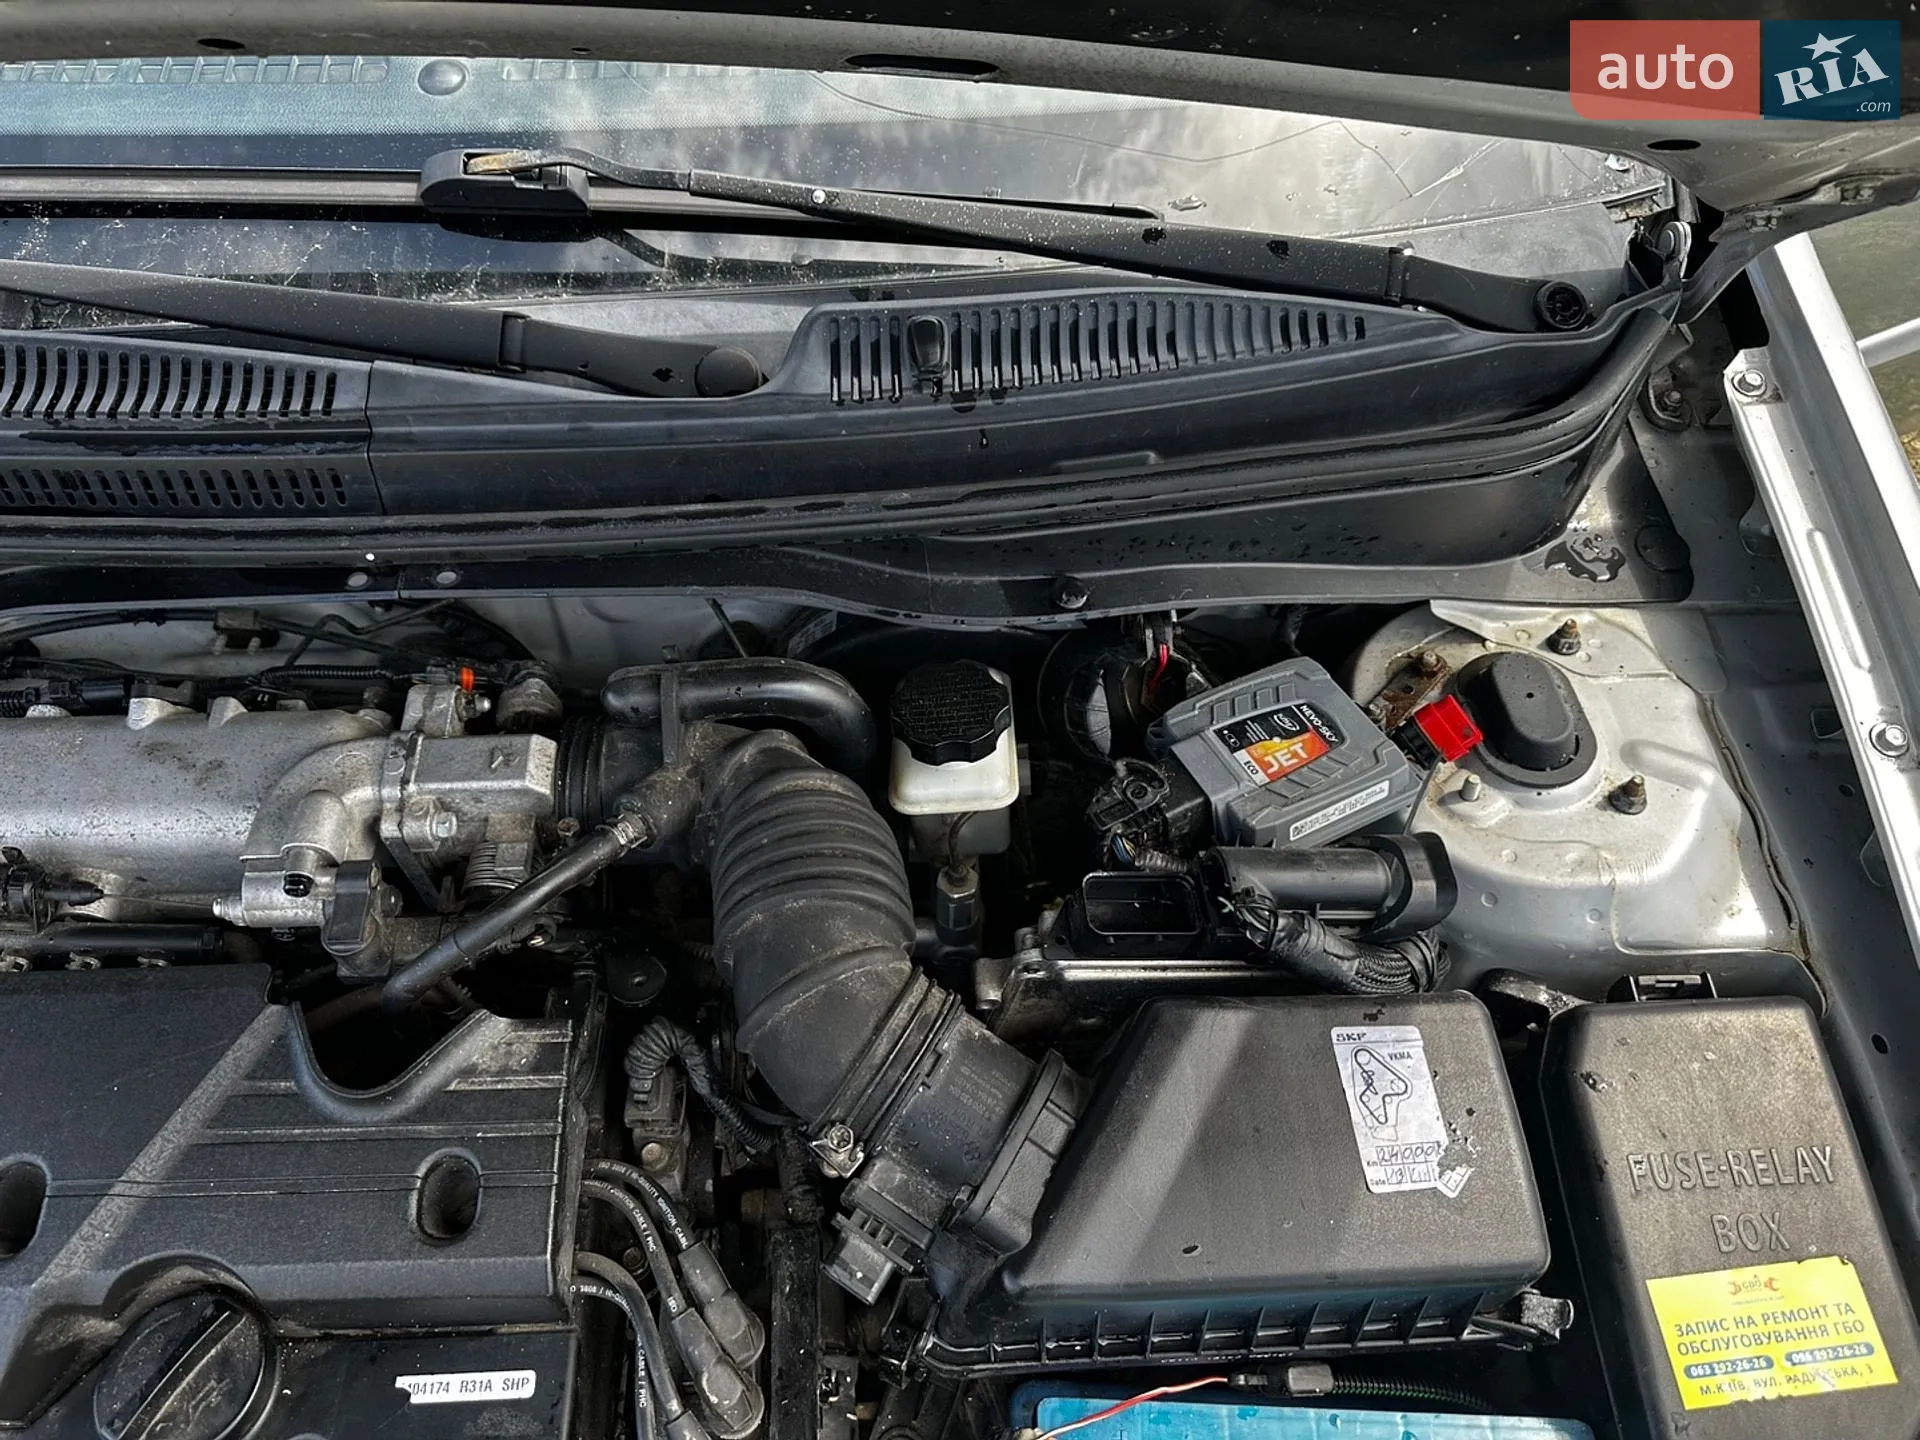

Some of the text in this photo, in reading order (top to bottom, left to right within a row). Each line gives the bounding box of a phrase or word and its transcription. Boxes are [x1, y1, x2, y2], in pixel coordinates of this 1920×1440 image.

[1299, 705, 1339, 742] NEVO-SKY
[1264, 742, 1309, 774] JET
[1336, 1032, 1367, 1042] SKF
[1626, 1145, 1836, 1191] FUSE-RELAY
[1710, 1211, 1791, 1254] BOX
[1674, 1302, 1857, 1338] ЗАПИС НА РЕМОНТ ТА
[1677, 1319, 1865, 1356] ОБСЛУГОВУВАННЯ ГБО
[459, 1379, 493, 1394] R31A
[501, 1377, 530, 1391] SHP
